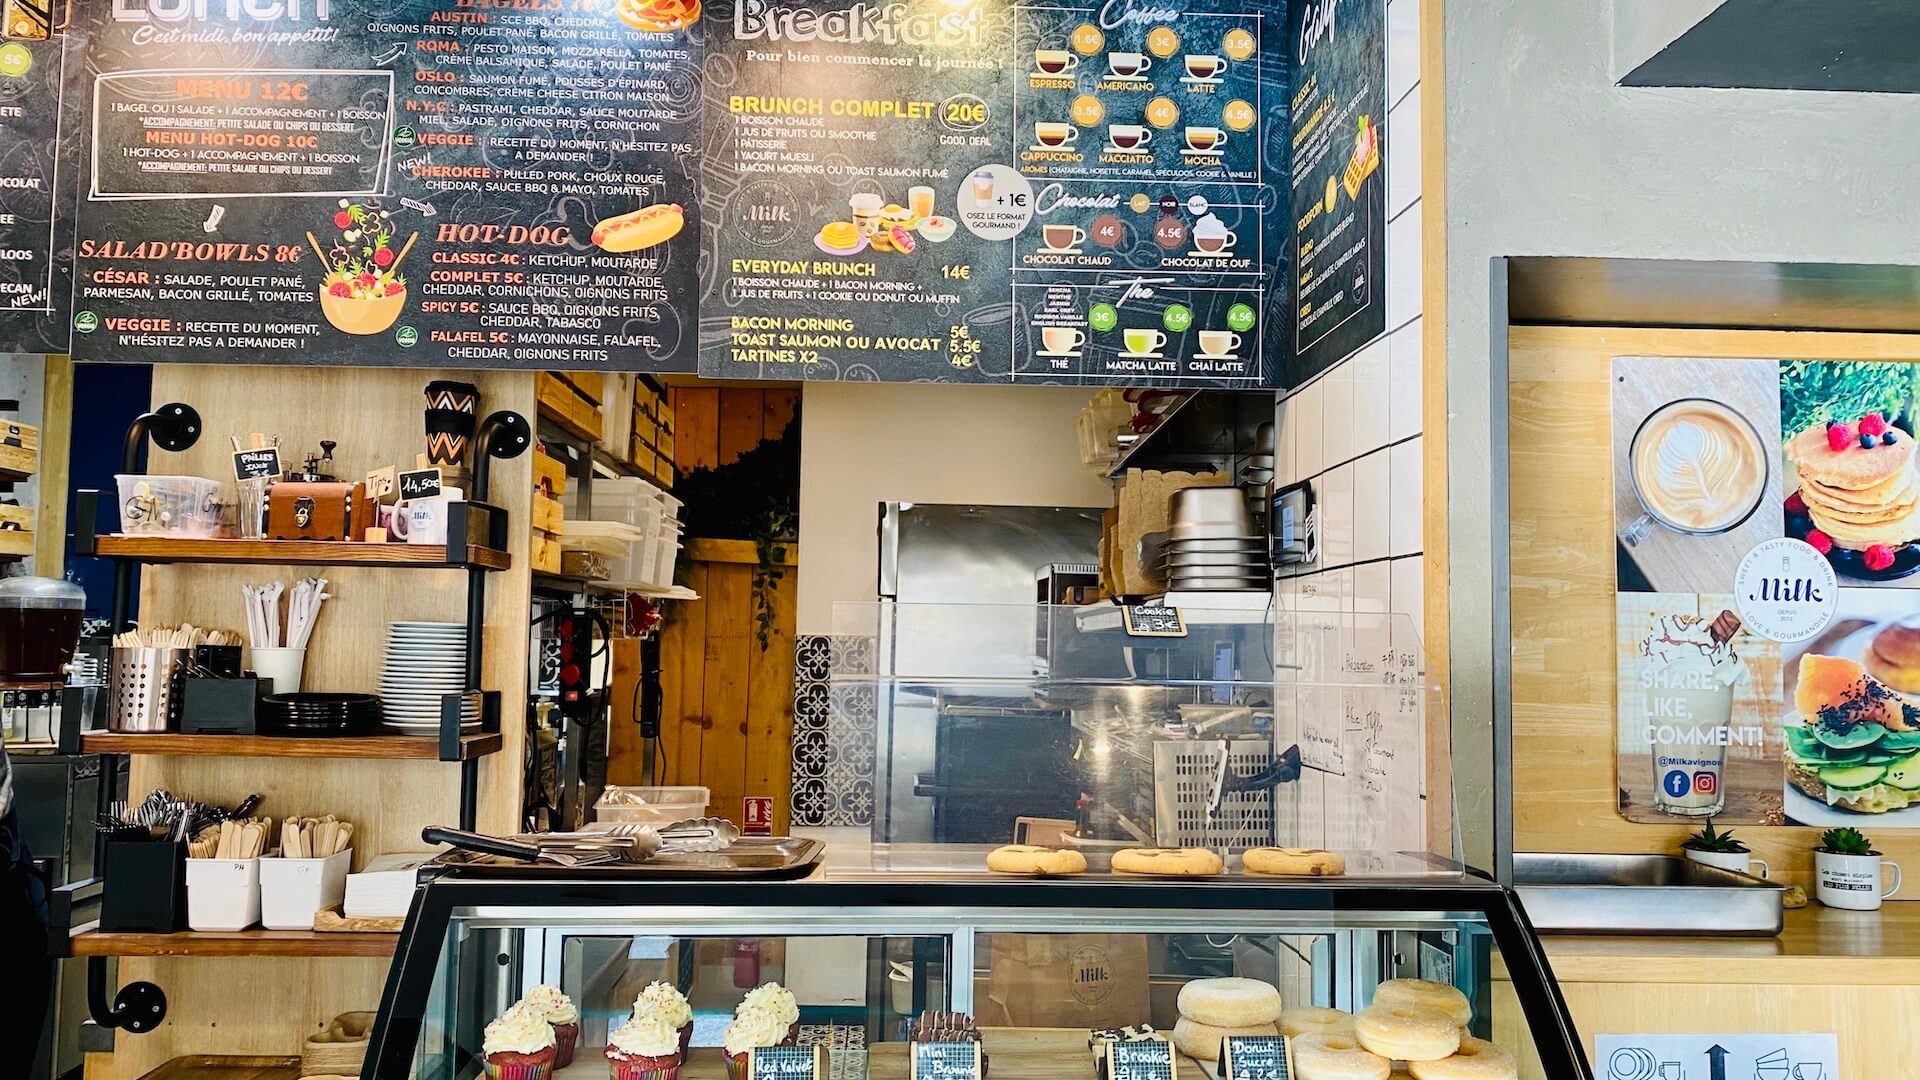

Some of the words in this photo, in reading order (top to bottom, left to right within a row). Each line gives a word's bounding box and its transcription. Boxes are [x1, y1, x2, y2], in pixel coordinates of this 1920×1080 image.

[431, 12, 487, 22] AUSTIN
[501, 16, 521, 24] SCE
[525, 17, 549, 27] BBQ,
[554, 17, 609, 28] CHEDDAR,
[1100, 0, 1179, 30] Coffee
[734, 0, 993, 47] Breakfast
[232, 27, 267, 42] bon
[416, 41, 460, 51] ROMA
[474, 44, 507, 53] PESTO
[512, 45, 558, 56] MAISON,
[562, 46, 634, 58] MOZZARELLA,
[638, 48, 690, 60] TOMATES,
[1156, 37, 1169, 46] 3€
[1228, 39, 1251, 49] 3.5€
[746, 51, 782, 63] Pour
[788, 51, 819, 64] bien
[826, 53, 913, 67] commencer
[917, 54, 931, 67] la
[415, 71, 455, 82] OSLO
[469, 74, 515, 85] SAUMON
[555, 76, 604, 87] POUSSES
[1030, 79, 1075, 89] ESPRESSO
[1097, 82, 1154, 91] AMERICANO
[1188, 84, 1215, 94] LATTE
[175, 80, 251, 99] MENU
[261, 82, 308, 100] 12€
[117, 104, 149, 112] BAGEL
[152, 104, 168, 113] OU
[177, 105, 214, 114] SALADE
[231, 108, 327, 118] ACCOMPAGNEMENT
[343, 111, 385, 120] BOISSON
[730, 96, 823, 115] BRUNCH
[830, 100, 934, 119] COMPLET
[947, 103, 985, 123] 20€
[1155, 108, 1168, 118] 4€
[1226, 109, 1250, 119] 4.5€
[741, 116, 782, 124] BOISSON
[786, 117, 824, 126] CHAUDE
[146, 132, 195, 144] MENU
[199, 132, 280, 146] HOT-DOG
[286, 136, 318, 148] 10€
[940, 135, 967, 146] GOOD
[741, 152, 777, 160] YAOURT
[781, 153, 814, 161] MUESLI
[1021, 152, 1084, 162] CAPPUCCINO
[1099, 154, 1154, 164] MACCIATTO
[1185, 156, 1221, 165] MOCHA
[1035, 183, 1121, 215] Chocolat
[967, 212, 984, 220] OSEZ
[997, 213, 1026, 221] FORMAT
[436, 223, 570, 245] HOT-DOG
[972, 222, 1016, 230] GOURMAND
[1100, 226, 1115, 237] 4€
[1158, 228, 1182, 238] 4.5€
[79, 239, 269, 262] SALAD'BOWLS
[275, 246, 301, 263] 8€
[432, 253, 496, 265] CLASSIC
[500, 254, 519, 265] 4€
[529, 255, 587, 268] KETCHUP,
[591, 257, 657, 269] MOUTARDE
[1023, 255, 1075, 265] CHOCOLAT
[1078, 256, 1112, 266] CHAUD
[1161, 258, 1212, 268] CHOCOLAT
[1216, 259, 1229, 268] DE
[1231, 259, 1250, 268] OUF
[93, 267, 148, 283] CÉSAR
[164, 275, 216, 288] SALADE,
[220, 276, 267, 287] POULET
[732, 259, 808, 274] EVERYDAY
[813, 261, 876, 276] BRUNCH
[941, 265, 970, 280] 14€
[732, 317, 781, 330] BACON
[784, 318, 854, 331] MORNING
[1095, 312, 1109, 321] 3€
[1166, 313, 1188, 324] 4.5€
[1230, 312, 1252, 322] 4.5€
[950, 326, 968, 339] 5€
[732, 333, 775, 347] TOAST
[779, 335, 841, 349] SAUMON
[845, 337, 869, 350] OU
[874, 337, 941, 351] AVOCAT
[949, 339, 981, 353] 5.5€
[732, 349, 796, 363] TARTINES
[800, 351, 818, 364] X2
[952, 354, 972, 367] 4€
[1050, 359, 1069, 369] THÉ
[1106, 361, 1146, 370] MATCHA
[1149, 362, 1176, 371] LATTE
[1215, 362, 1244, 372] LATTE
[1749, 578, 1823, 602] Milk
[1135, 606, 1175, 616] Cookie
[1641, 669, 1720, 692] SHARE,
[1642, 697, 1693, 719] LIKE,
[1643, 725, 1763, 747] COMMENT!
[1232, 1041, 1274, 1054] Donut
[1118, 1048, 1171, 1064] Brookie
[756, 1057, 778, 1073] Red
